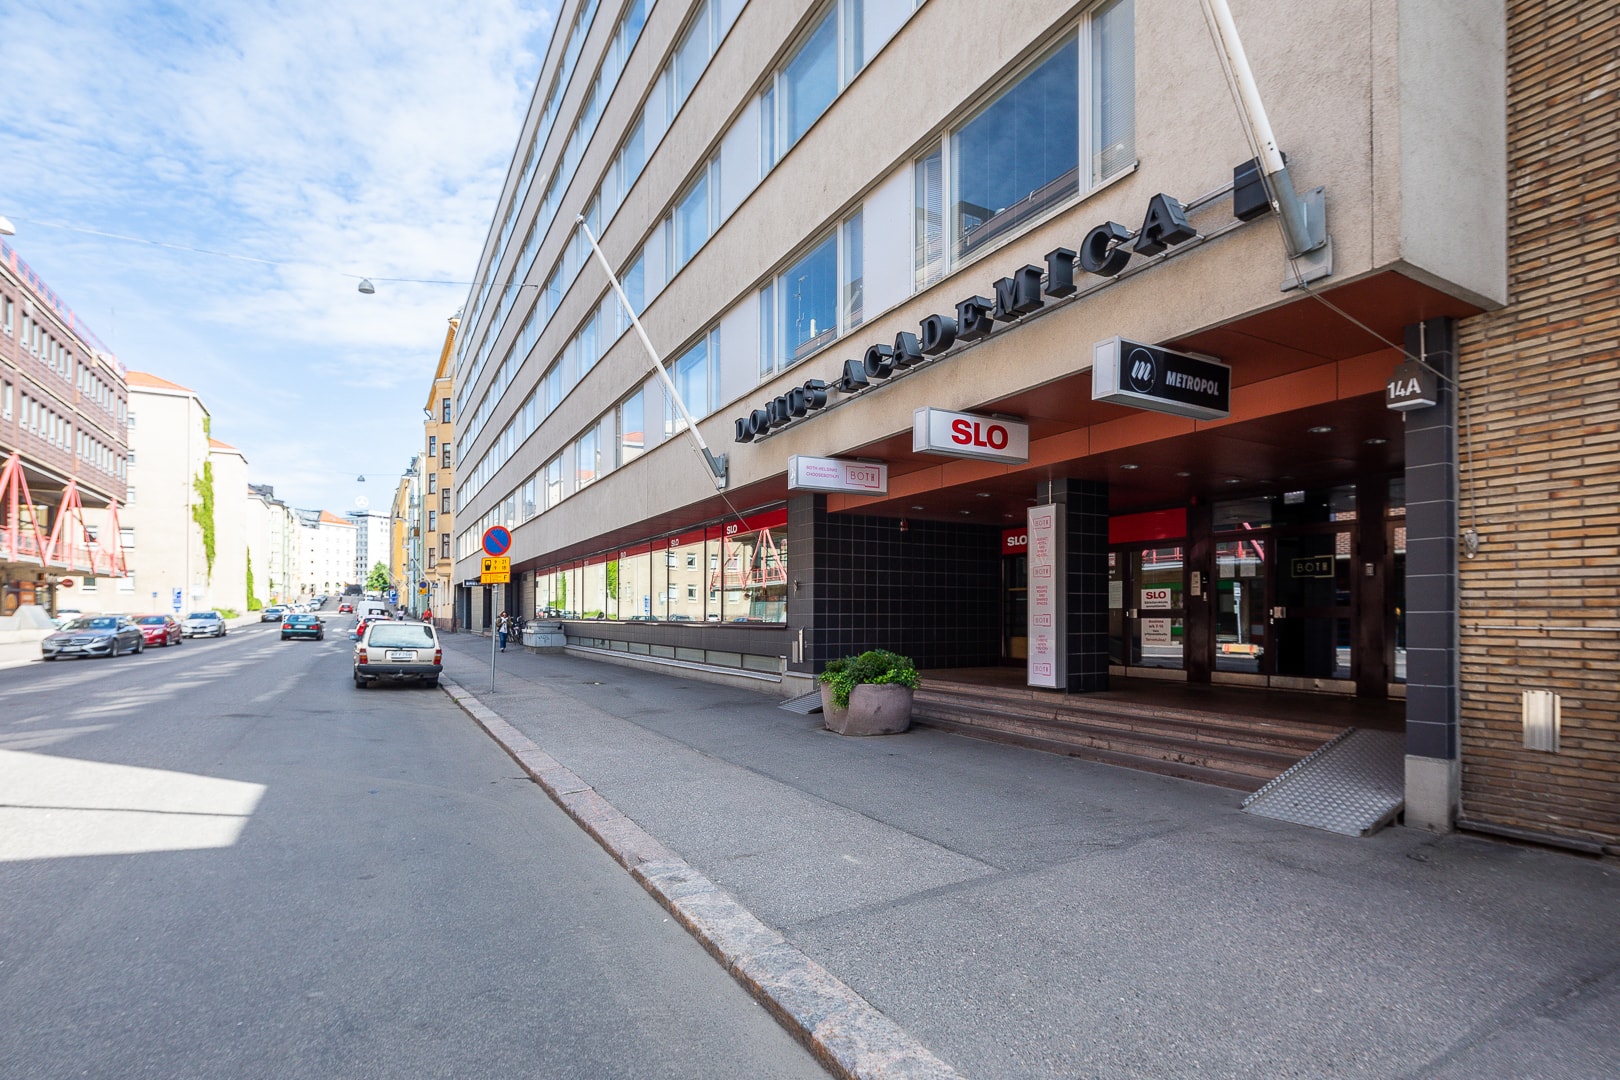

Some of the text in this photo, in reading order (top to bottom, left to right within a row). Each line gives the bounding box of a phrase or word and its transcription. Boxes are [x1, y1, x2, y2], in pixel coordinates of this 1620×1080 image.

[734, 192, 1197, 444] DOMUS ACADEMICA
[1165, 370, 1220, 396] METROPOL
[1387, 377, 1421, 399] 14A
[951, 418, 1008, 450] SLO
[850, 470, 875, 482] BOTH
[726, 524, 738, 535] SLO
[1007, 535, 1027, 547] SLO
[1296, 561, 1328, 573] BOTH
[1145, 591, 1167, 600] SLO
